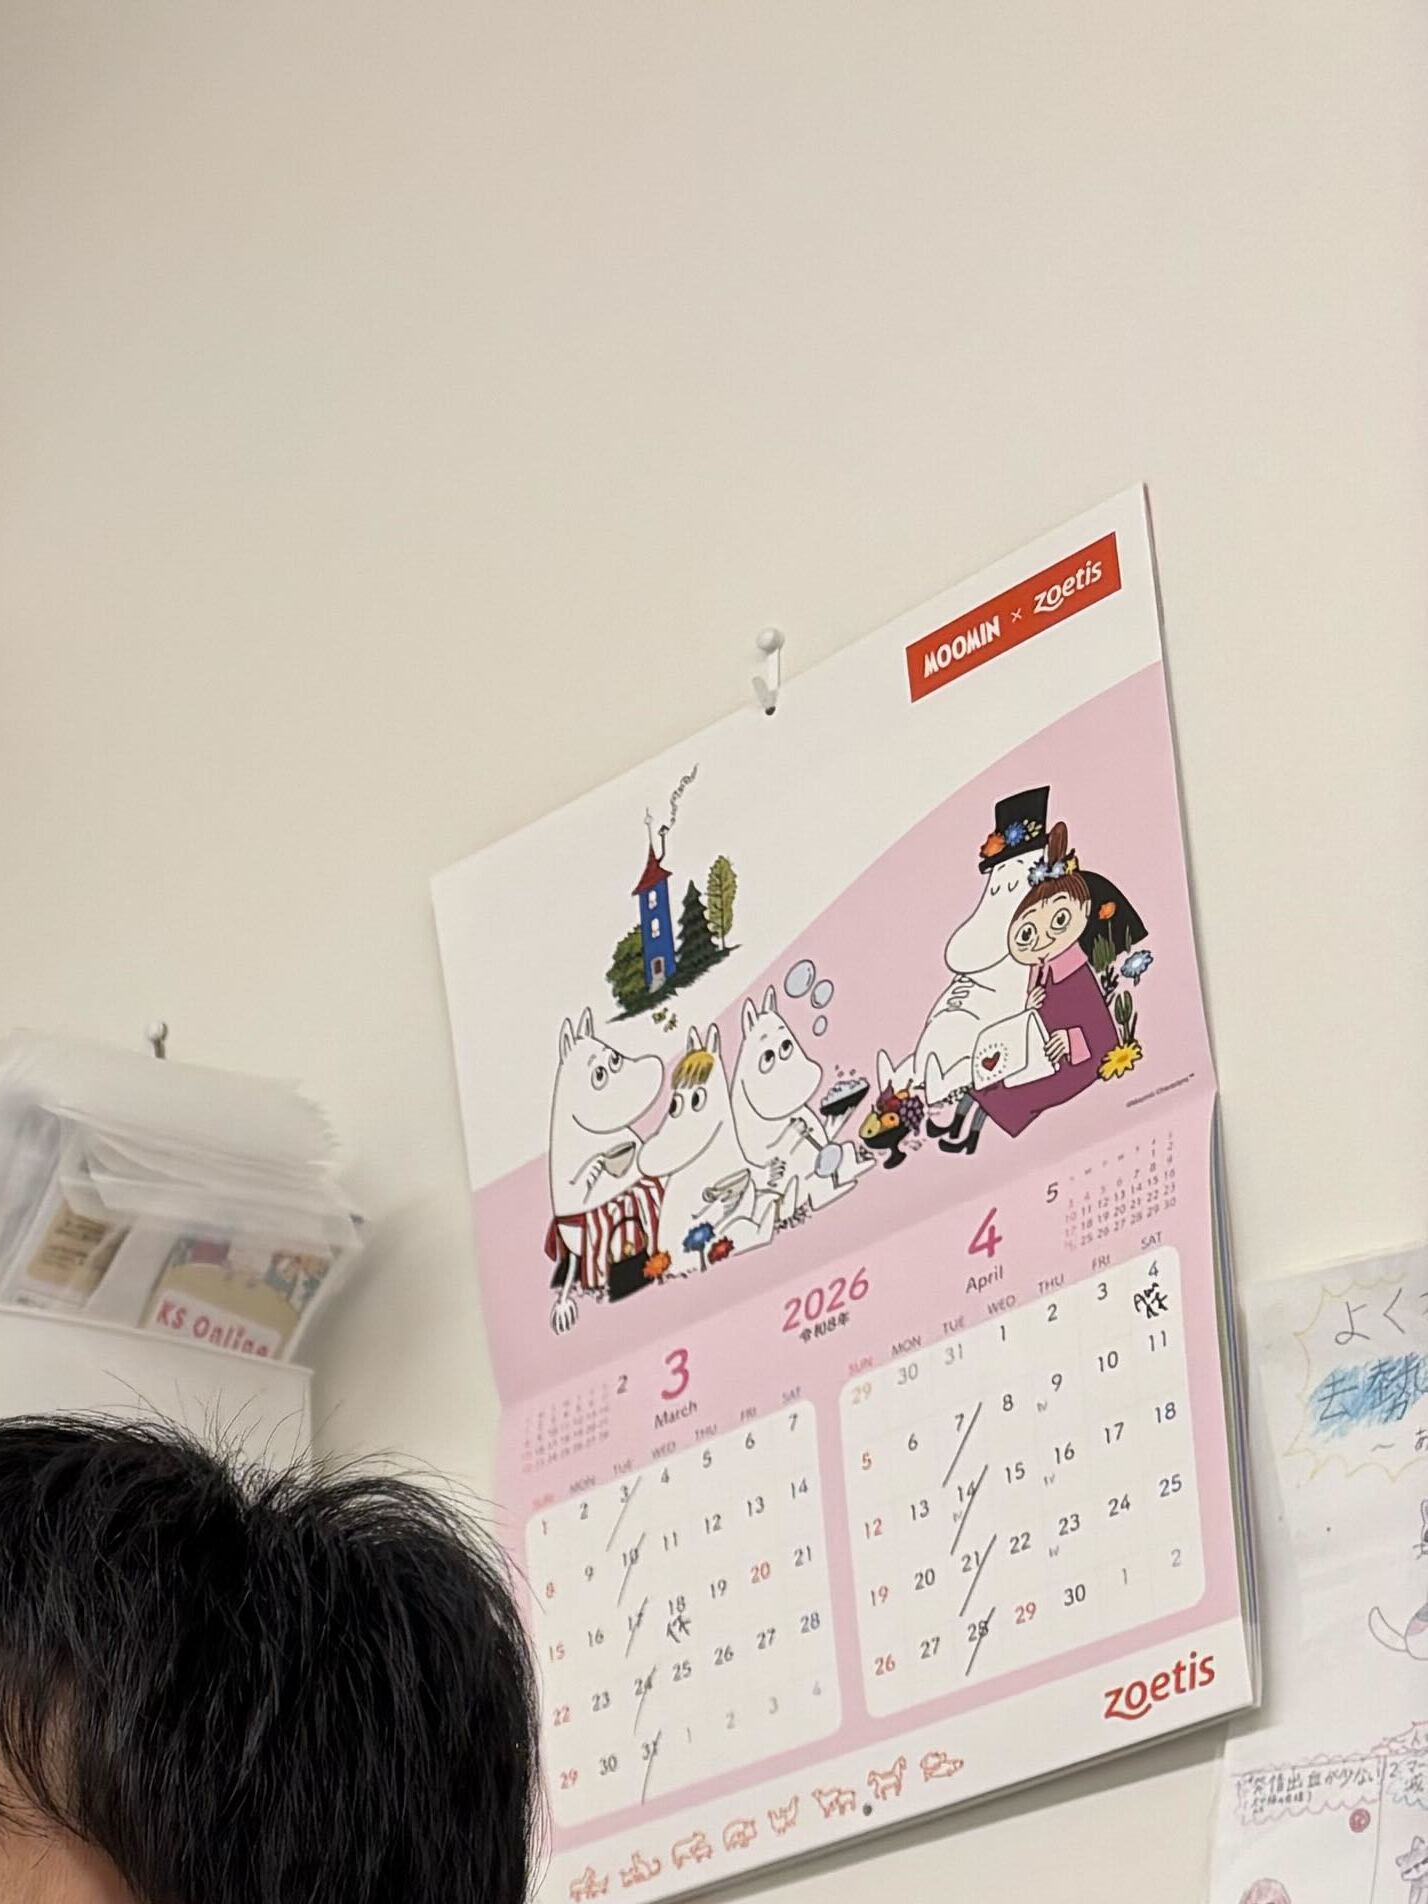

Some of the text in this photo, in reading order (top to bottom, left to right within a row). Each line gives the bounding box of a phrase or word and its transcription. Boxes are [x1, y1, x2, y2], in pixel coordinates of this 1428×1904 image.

[924, 559, 1103, 679] MOOMIN zoetis
[1045, 1181, 1059, 1204] 5
[967, 1206, 1003, 1258] 4
[782, 1265, 869, 1333] 2026
[891, 1335, 922, 1356] MON
[987, 1294, 1017, 1316] WED
[1037, 1273, 1065, 1293] THU
[1090, 1254, 1111, 1273] FRI
[1141, 1231, 1162, 1250] SAT
[965, 1266, 1005, 1295] April
[851, 1260, 1159, 1405] 29 30 31 2 3 4
[617, 1374, 629, 1395] 2
[661, 1348, 689, 1400] 3
[861, 1329, 1168, 1471] 5 6 7 8 9 10 11
[654, 1400, 698, 1430] March
[702, 1431, 755, 1469] 5 6
[864, 1402, 1177, 1540] 12 13 15 16 17 18
[663, 1477, 809, 1553] 11 12 13 14
[870, 1473, 1182, 1607] 19 20 21 22 23 24 25
[588, 1545, 813, 1648] 16 18 19 20 21
[874, 1548, 1181, 1676] 26 27 29 30 2
[553, 1611, 821, 1727] 22 23 25 26 27 28
[1103, 1650, 1216, 1722] zoetis
[560, 1754, 618, 1790] 29 30
